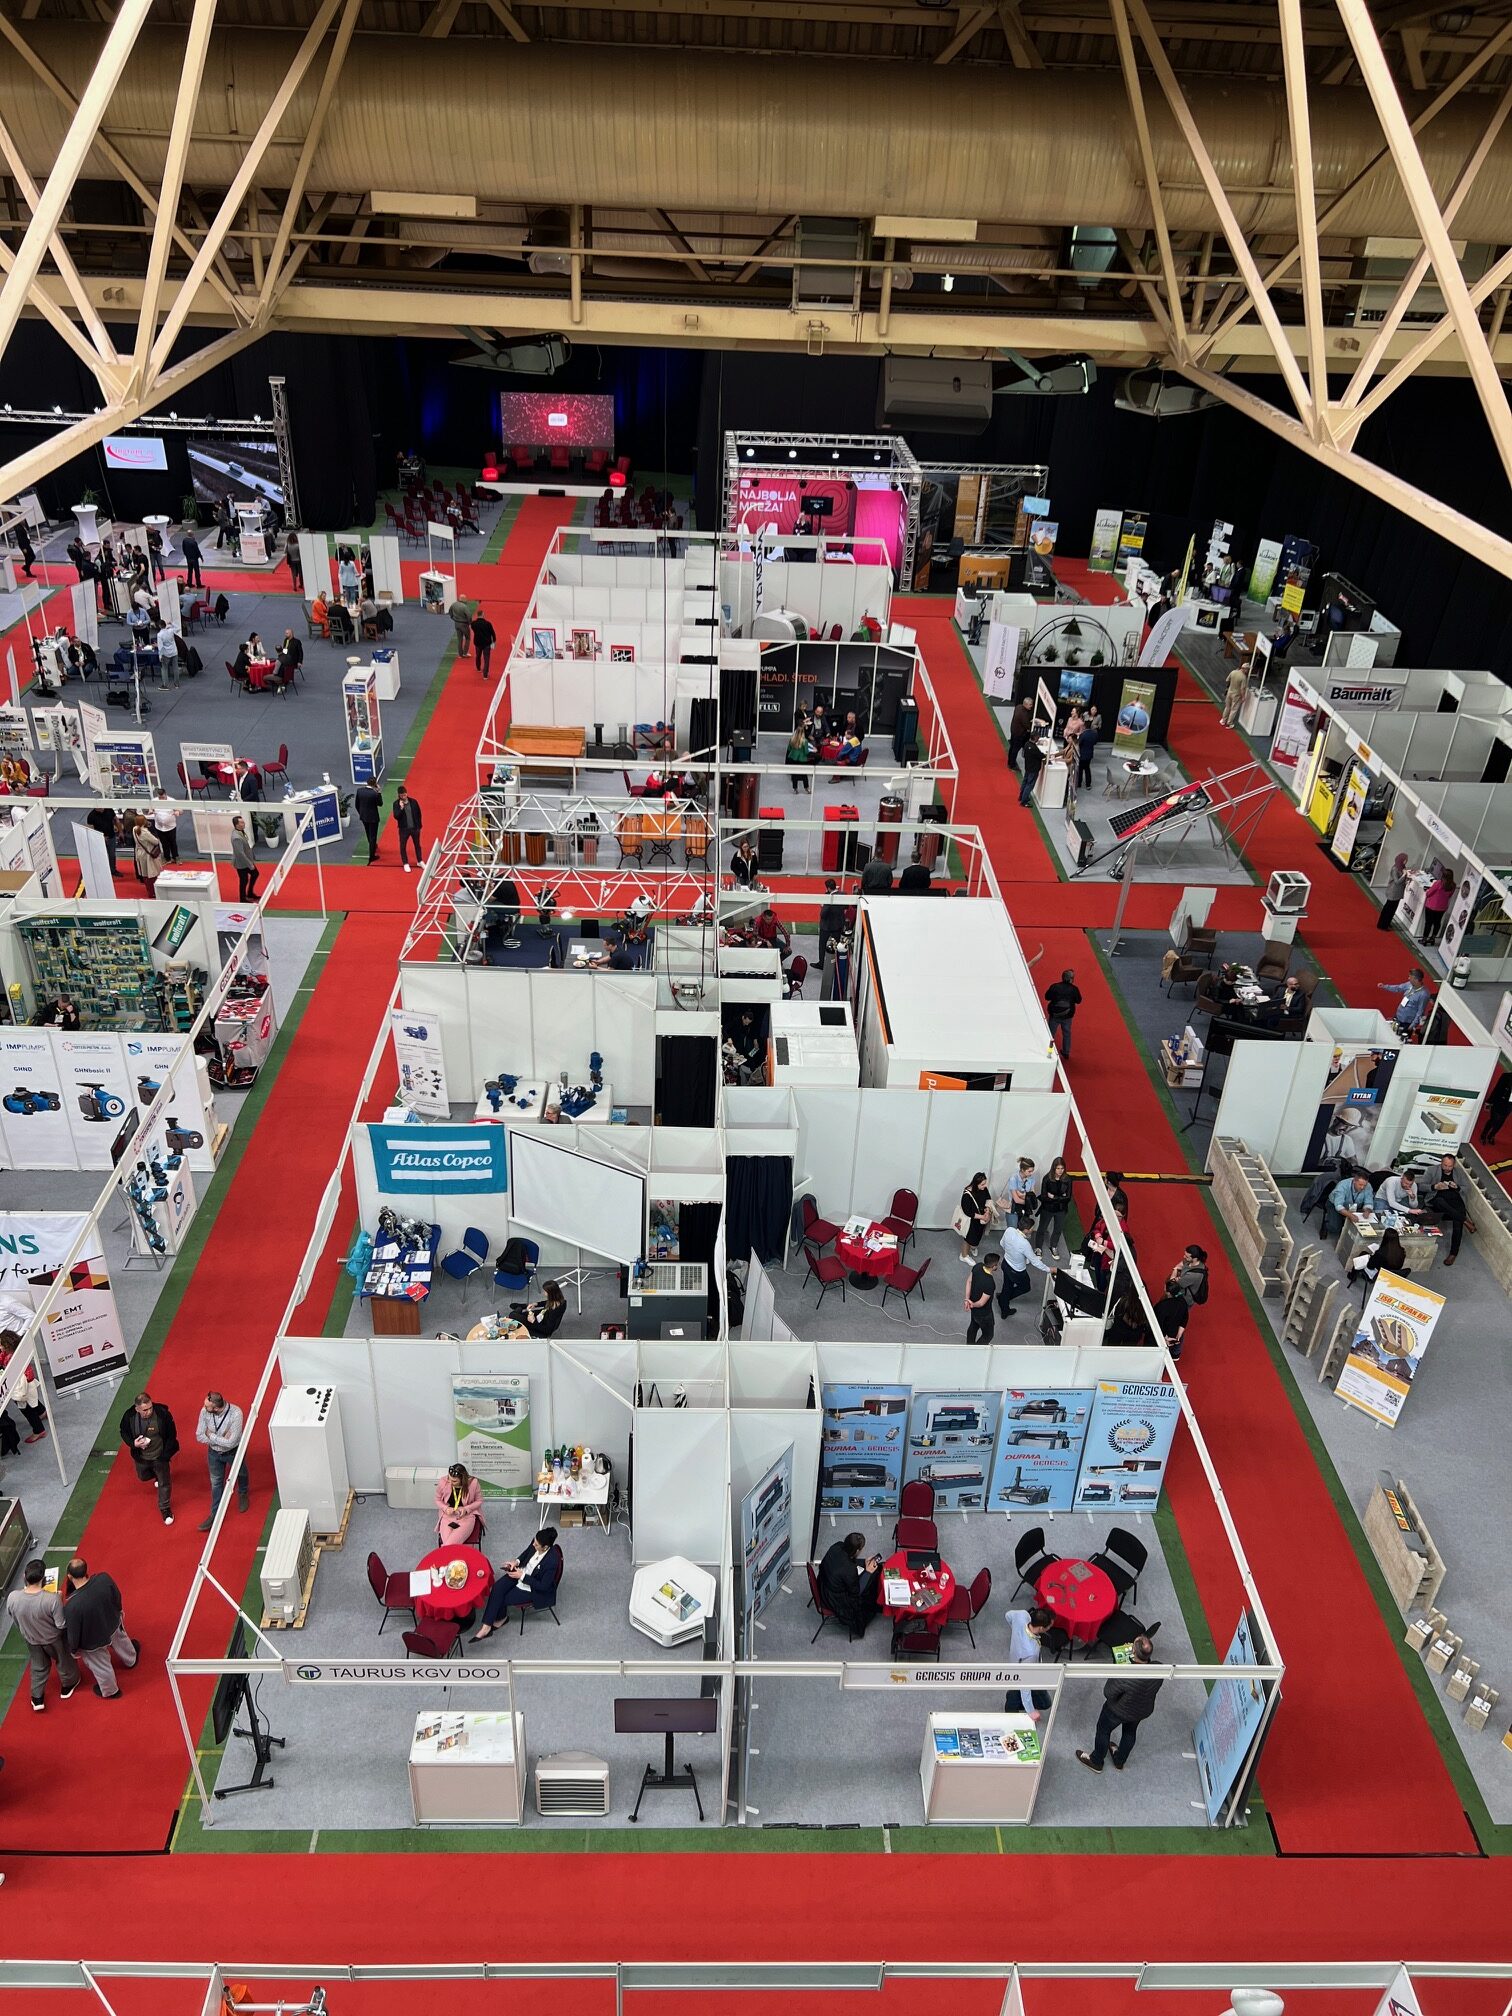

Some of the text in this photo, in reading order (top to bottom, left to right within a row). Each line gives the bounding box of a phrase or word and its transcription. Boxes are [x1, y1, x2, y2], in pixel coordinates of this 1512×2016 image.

[740, 490, 797, 502] NAJBOLJA
[30, 918, 60, 926] wolfcraft
[172, 911, 188, 943] wolfcraft
[389, 1152, 493, 1169] Atlas Copco
[12, 1263, 39, 1278] for
[63, 1304, 83, 1316] EMT
[1122, 1384, 1159, 1397] GENESIS
[329, 1668, 500, 1679] TAURUS KGV DOO
[915, 1671, 1022, 1682] GENESIS GRUPA d.o.o.
